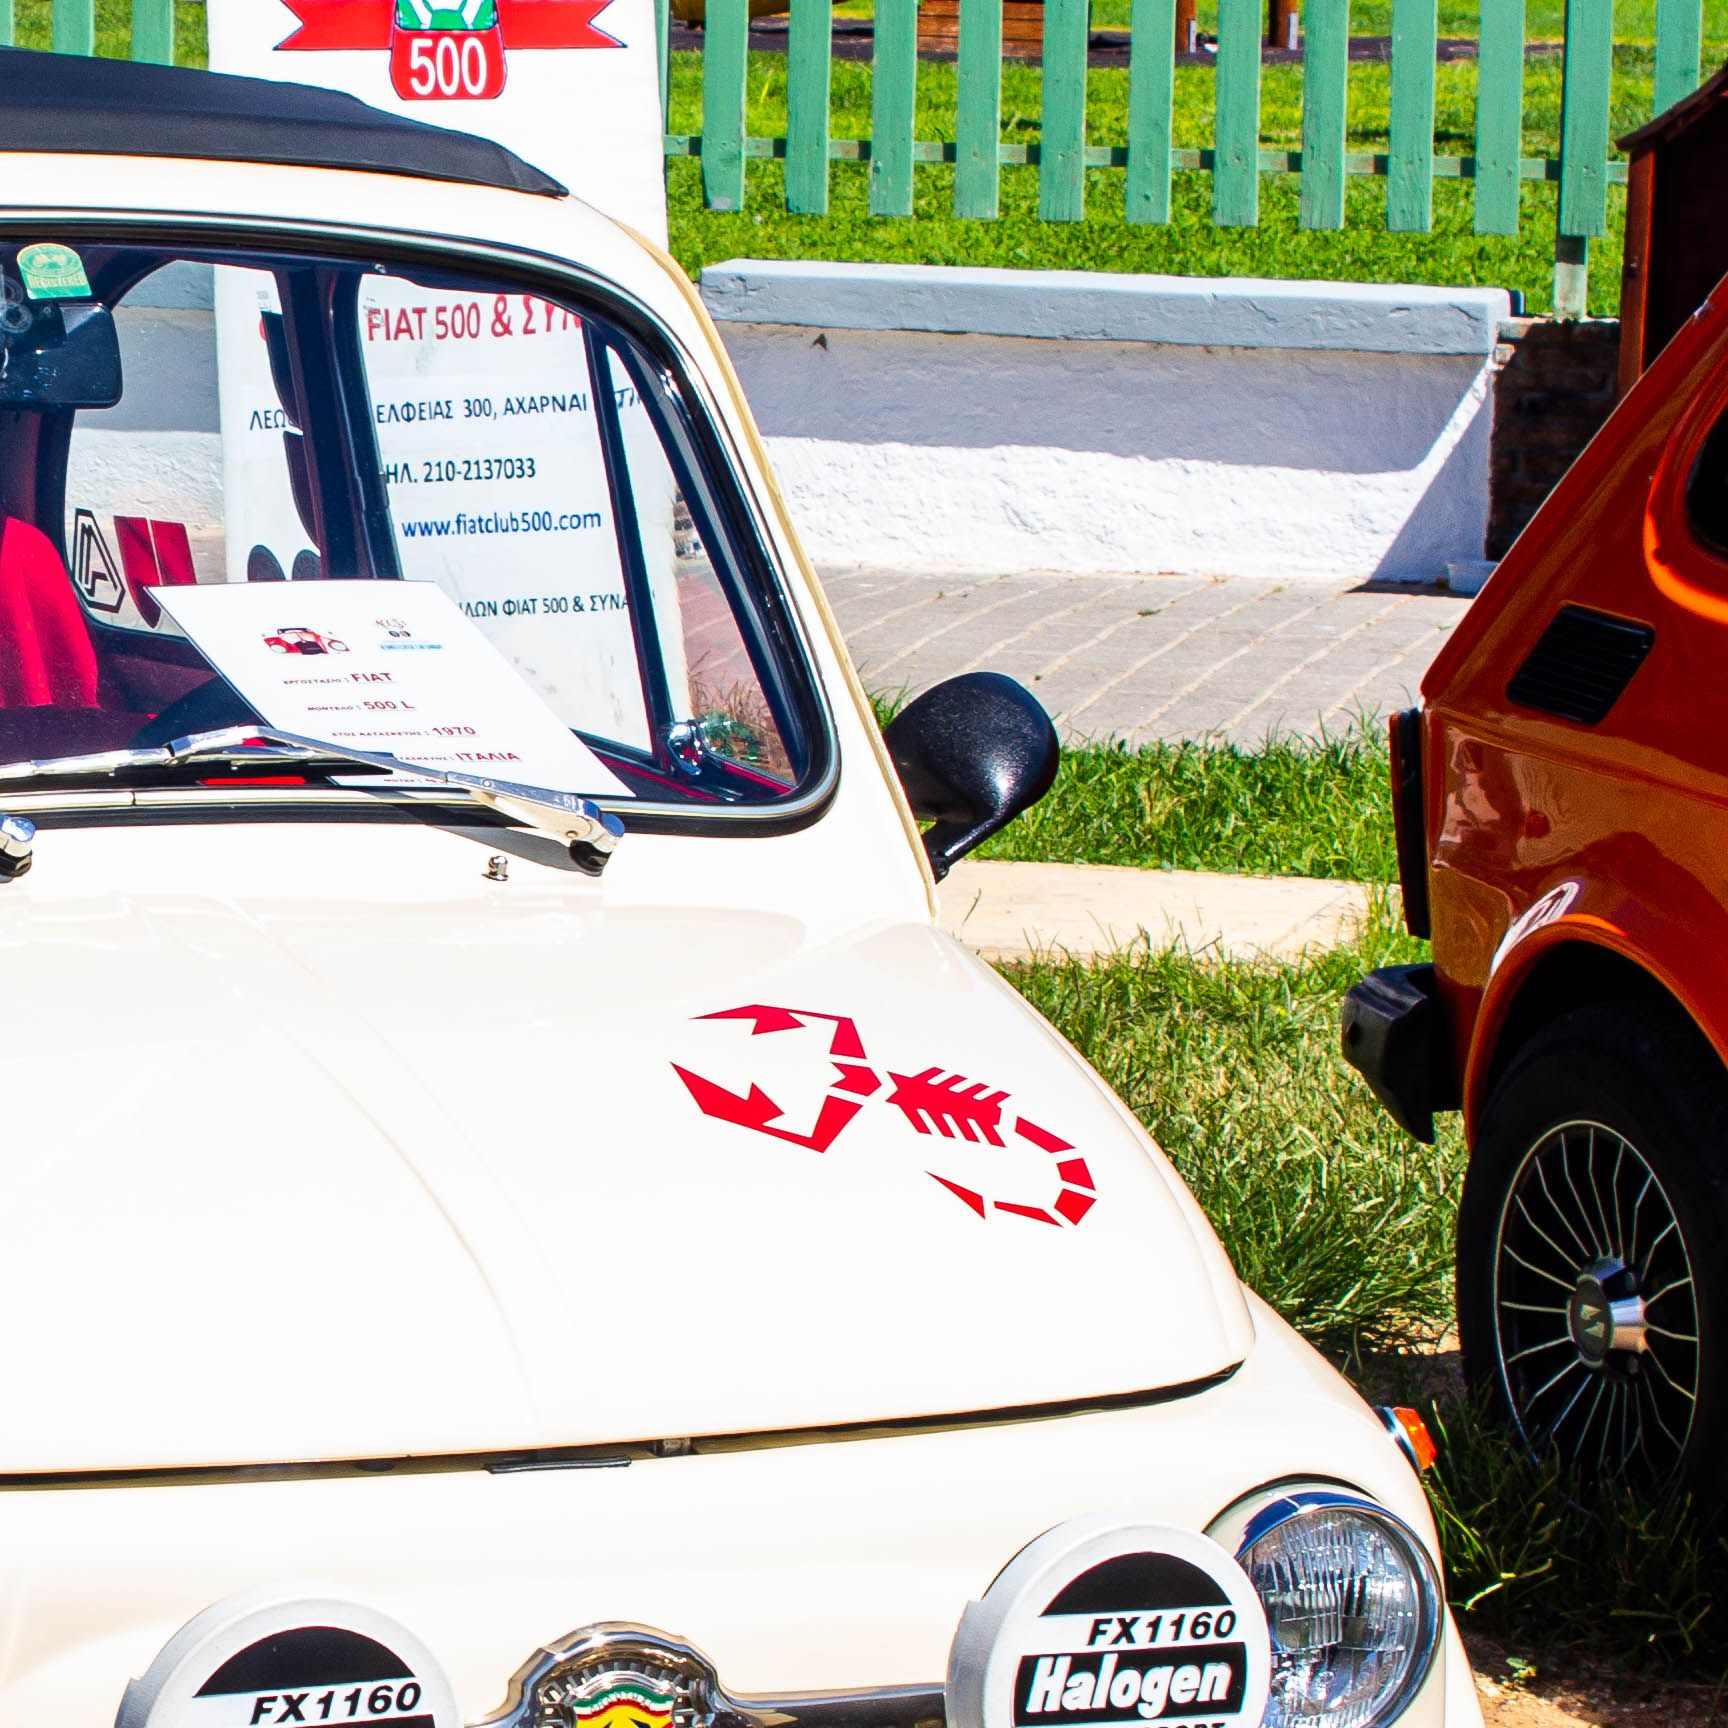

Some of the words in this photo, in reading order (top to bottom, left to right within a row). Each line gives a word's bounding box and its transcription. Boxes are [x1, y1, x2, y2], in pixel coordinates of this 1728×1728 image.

[407, 36, 489, 97] 500
[366, 306, 427, 341] FIAT
[435, 302, 481, 340] 500
[491, 294, 513, 337] &
[249, 408, 293, 431] ΛΕΩ
[376, 399, 454, 424] ΕΛΦΕΙΑΣ
[463, 398, 497, 421] 300,
[503, 392, 588, 416] ΑΧΑΡΝΑΙ
[385, 462, 418, 484] ΗΛ.
[423, 457, 537, 482] 210-2137033
[401, 511, 602, 538] www.fiatclub500.com
[542, 595, 569, 614] 500
[572, 594, 585, 613] &
[350, 672, 393, 683] FIAT
[363, 700, 397, 710] 500
[400, 700, 415, 710] L
[432, 725, 477, 736] 1970
[455, 751, 521, 762] ΙΤΑΛΙΑ
[1087, 1609, 1237, 1646] FX1160
[1025, 1652, 1233, 1719] Halogen
[249, 1681, 423, 1725] FX1160
